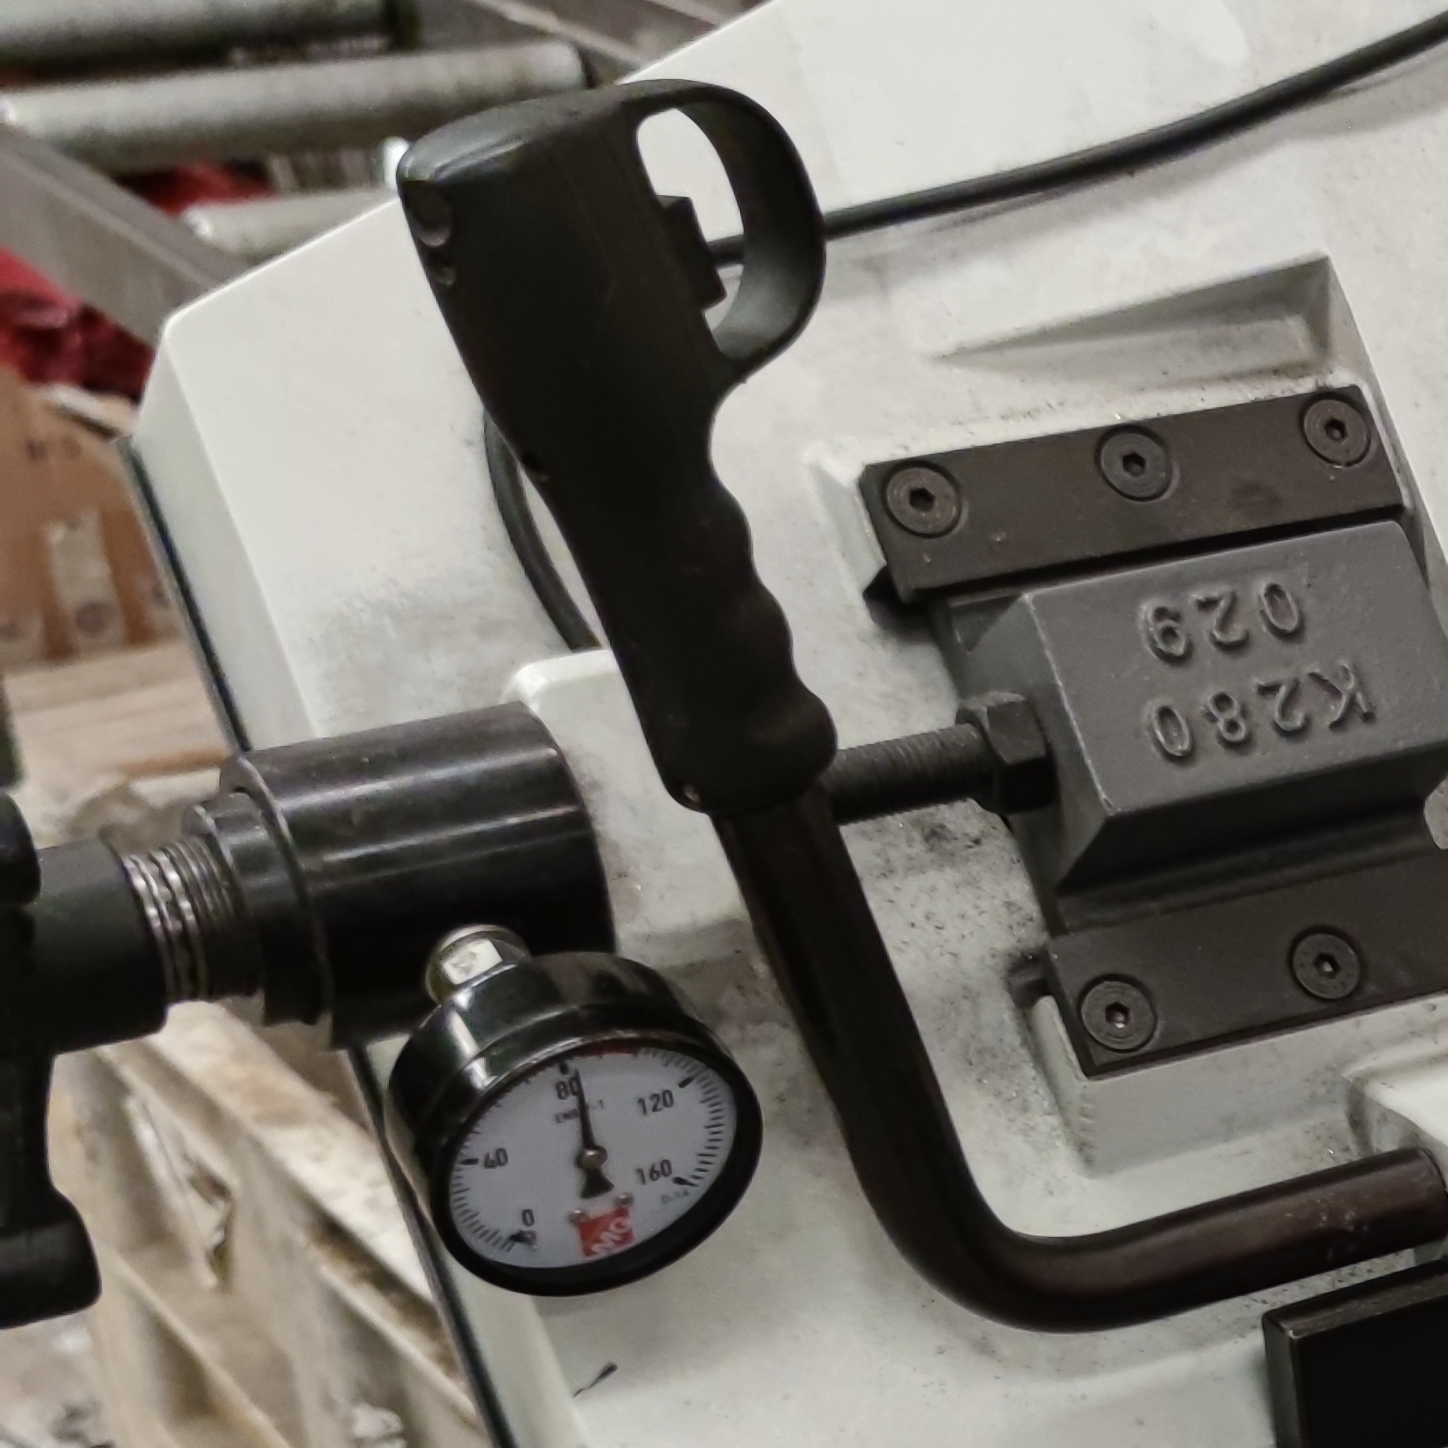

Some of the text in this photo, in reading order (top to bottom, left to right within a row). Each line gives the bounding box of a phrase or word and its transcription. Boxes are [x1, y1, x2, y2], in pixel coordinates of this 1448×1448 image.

[1139, 581, 1306, 661] 029
[1149, 662, 1377, 760] K280
[556, 1077, 581, 1100] 80
[637, 1089, 674, 1115] 120
[636, 1159, 672, 1185] 160
[522, 1208, 535, 1227] 0
